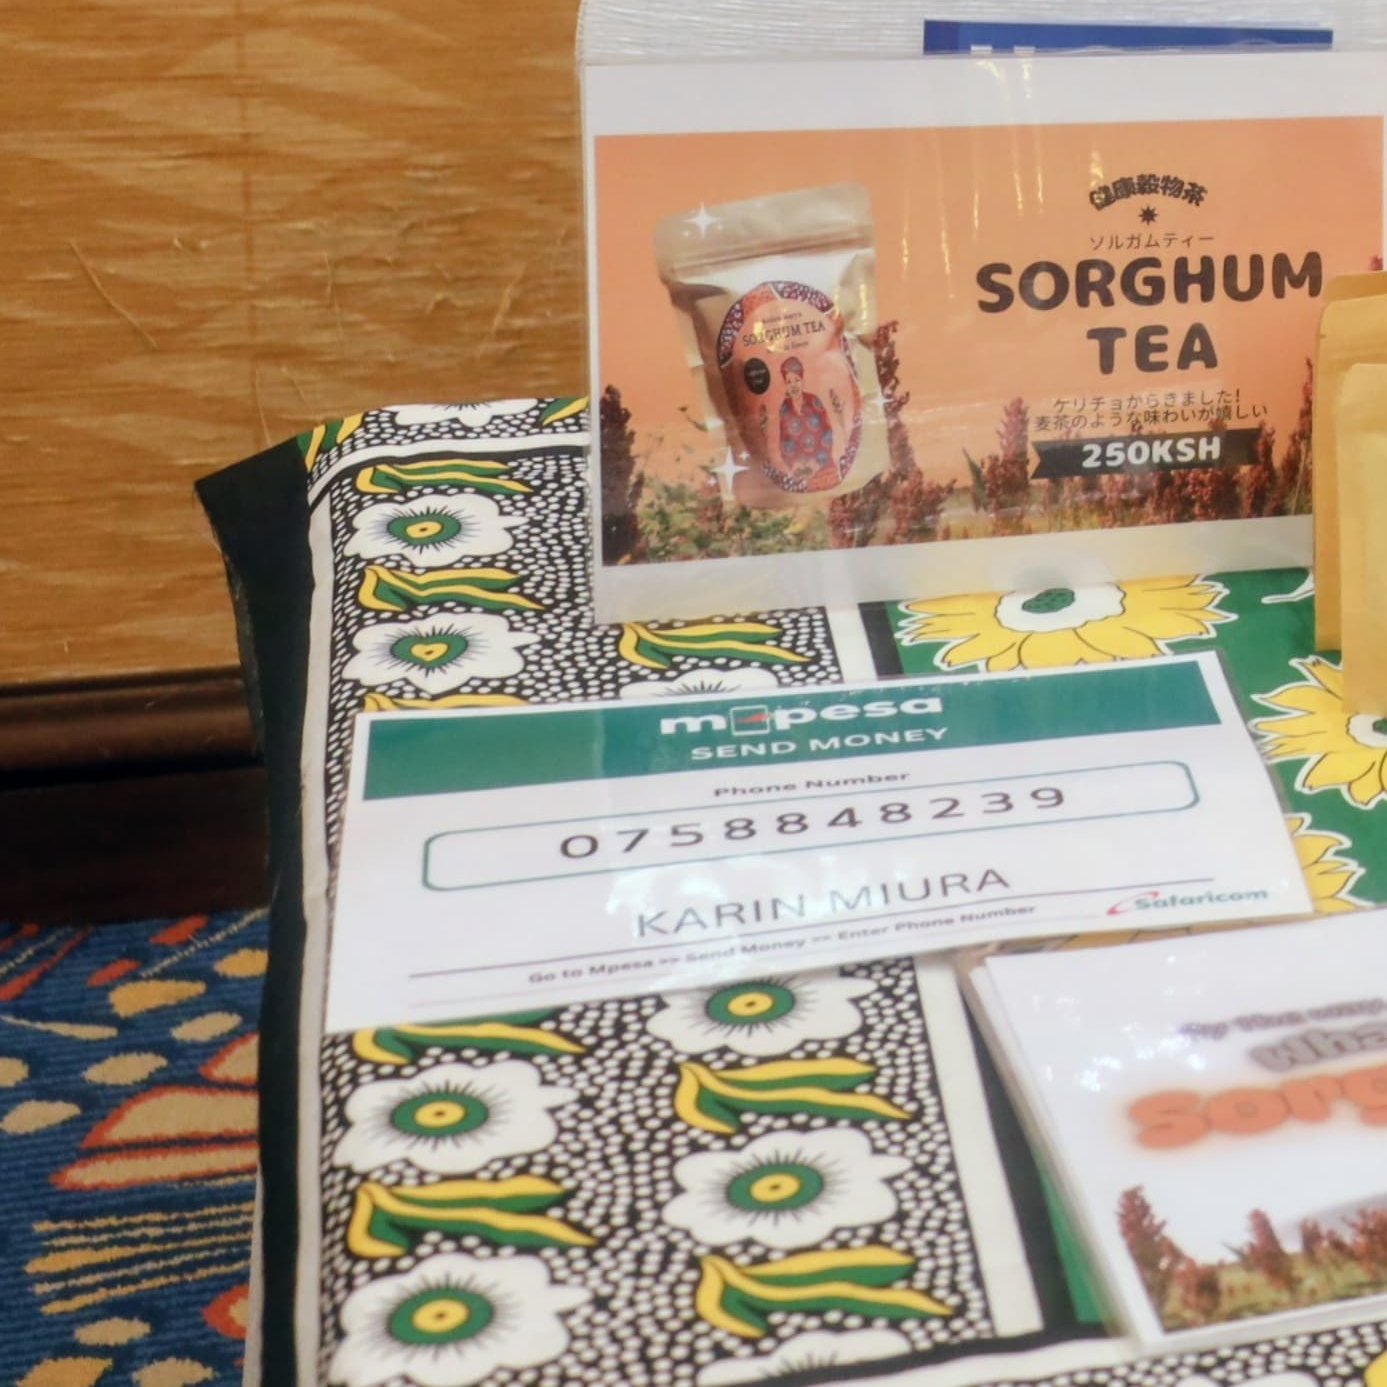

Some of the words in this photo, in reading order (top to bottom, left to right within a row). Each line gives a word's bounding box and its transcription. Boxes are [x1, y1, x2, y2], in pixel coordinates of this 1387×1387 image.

[1090, 232, 1215, 251] ソルガムティー
[976, 251, 1322, 314] SORGHUM
[1086, 322, 1218, 375] TEA
[1082, 435, 1221, 469] 250KSH
[690, 739, 797, 761] SEND
[808, 726, 950, 752] MONEY
[713, 781, 795, 798] Phone
[805, 771, 911, 790] Number
[559, 786, 1066, 860] 0758848239
[636, 893, 806, 938] KARIN
[829, 868, 1011, 915] MIURA
[1134, 889, 1269, 911] Safaricom
[528, 973, 556, 984] Go
[562, 968, 583, 979] to
[589, 959, 653, 975] Mpesa
[686, 947, 736, 963] Send
[740, 939, 807, 955] Money
[838, 925, 889, 940] Enter
[895, 917, 955, 932] Phone
[960, 904, 1037, 923] Number
